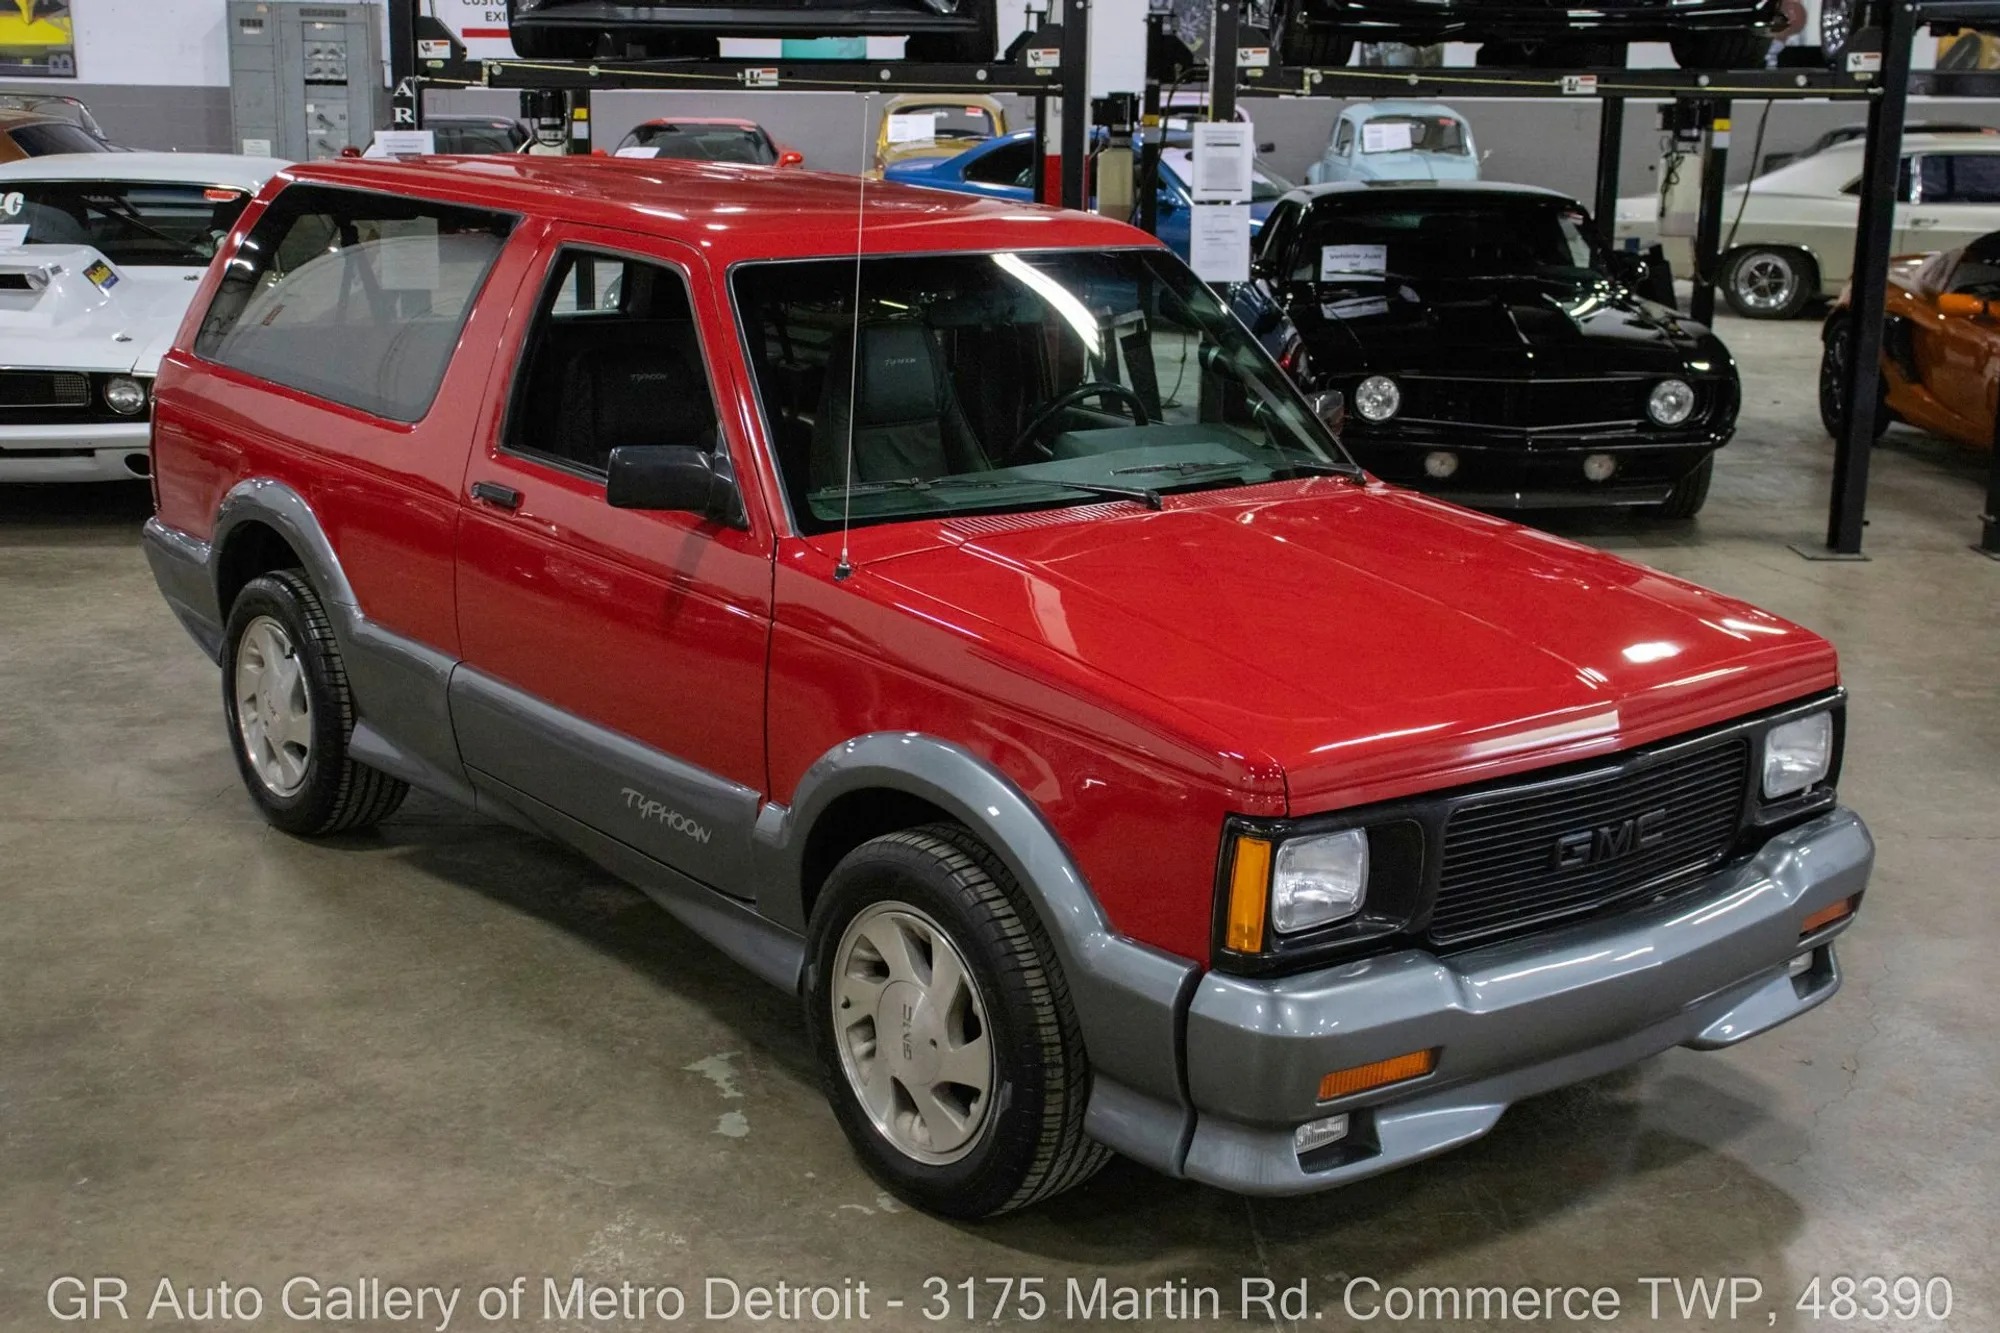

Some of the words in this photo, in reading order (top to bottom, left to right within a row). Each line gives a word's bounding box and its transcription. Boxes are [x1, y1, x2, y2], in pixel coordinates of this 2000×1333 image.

[621, 787, 712, 843] TYPHOON
[1553, 807, 1667, 871] GMC
[902, 1003, 913, 1061] GMC
